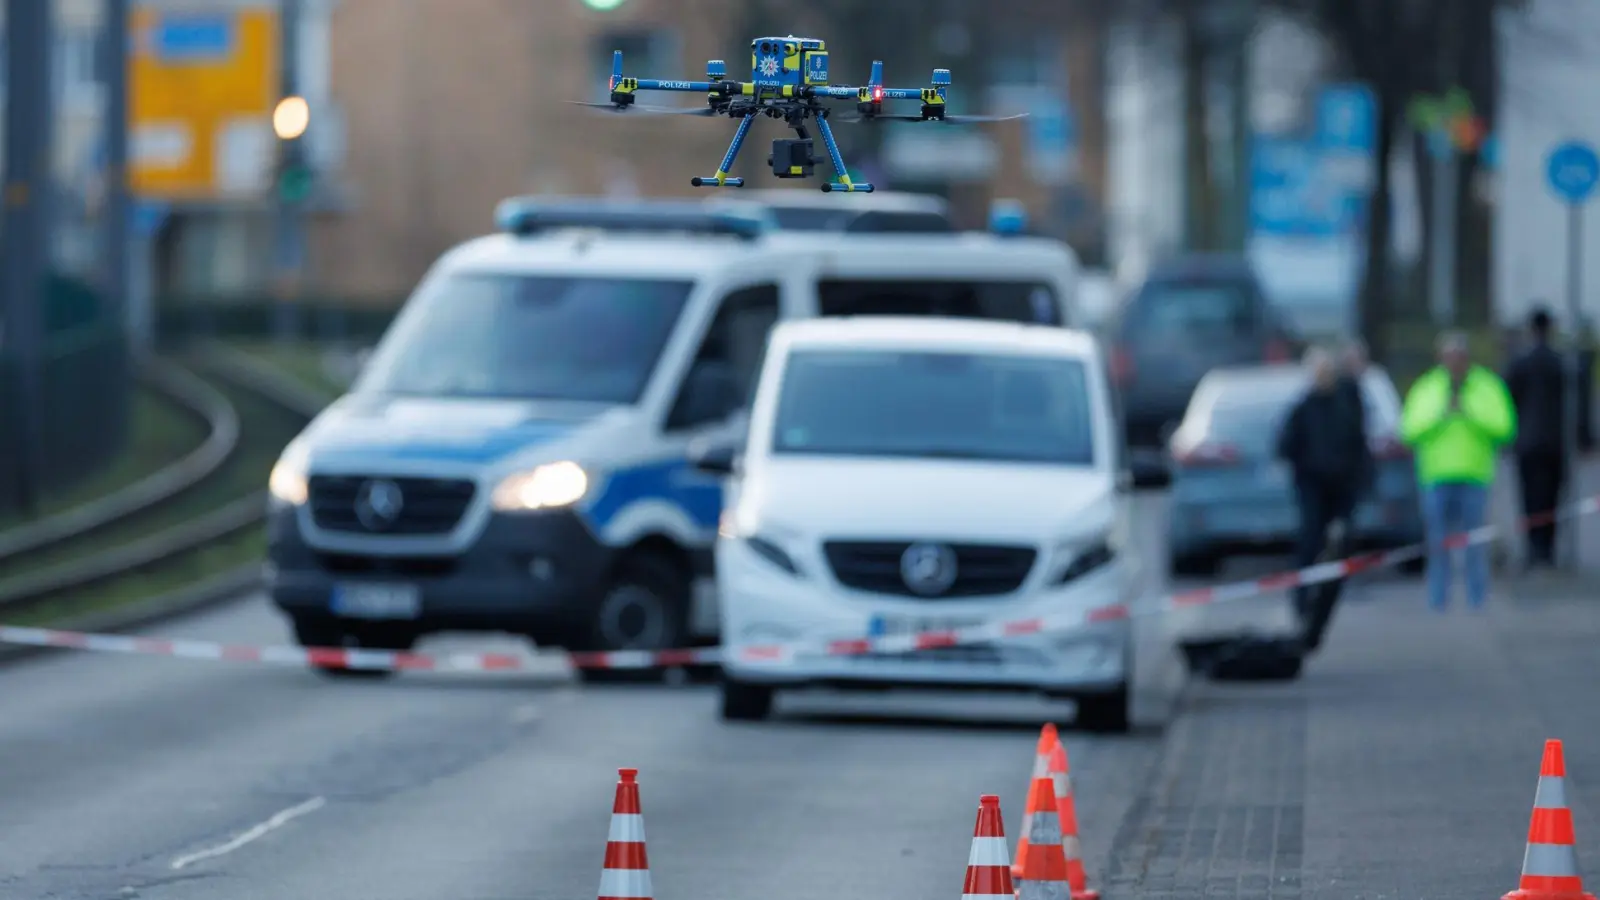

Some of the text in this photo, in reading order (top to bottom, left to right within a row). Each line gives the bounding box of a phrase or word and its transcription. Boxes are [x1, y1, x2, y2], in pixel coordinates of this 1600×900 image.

[810, 71, 828, 80] POLIZEI
[658, 80, 691, 89] POLIZEI
[879, 90, 907, 98] OLIZEI
